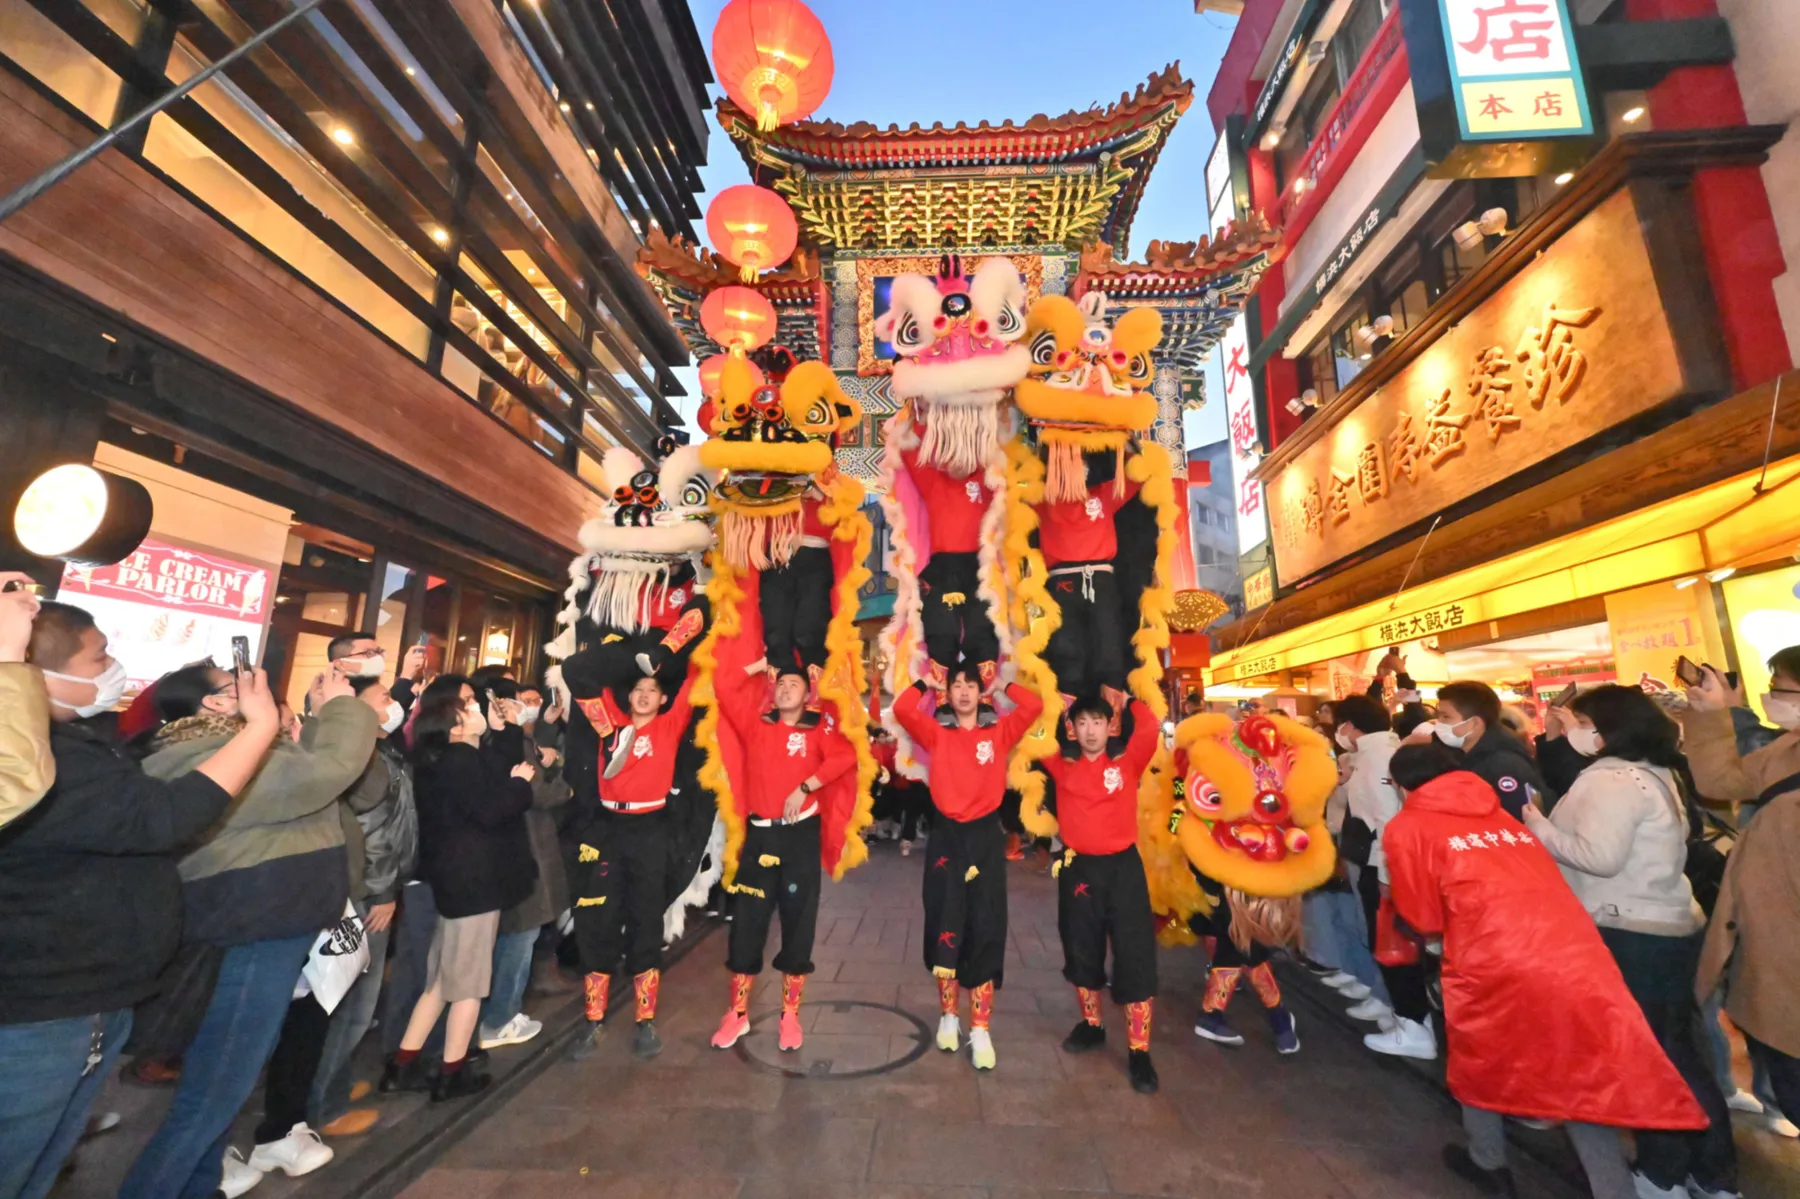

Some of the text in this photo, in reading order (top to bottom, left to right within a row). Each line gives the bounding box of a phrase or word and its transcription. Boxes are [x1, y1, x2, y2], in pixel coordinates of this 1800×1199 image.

[1479, 91, 1562, 120] 本店
[115, 567, 227, 605] PARLOR
[159, 557, 243, 592] CREAM
[1380, 604, 1464, 642] 横浜大飯店
